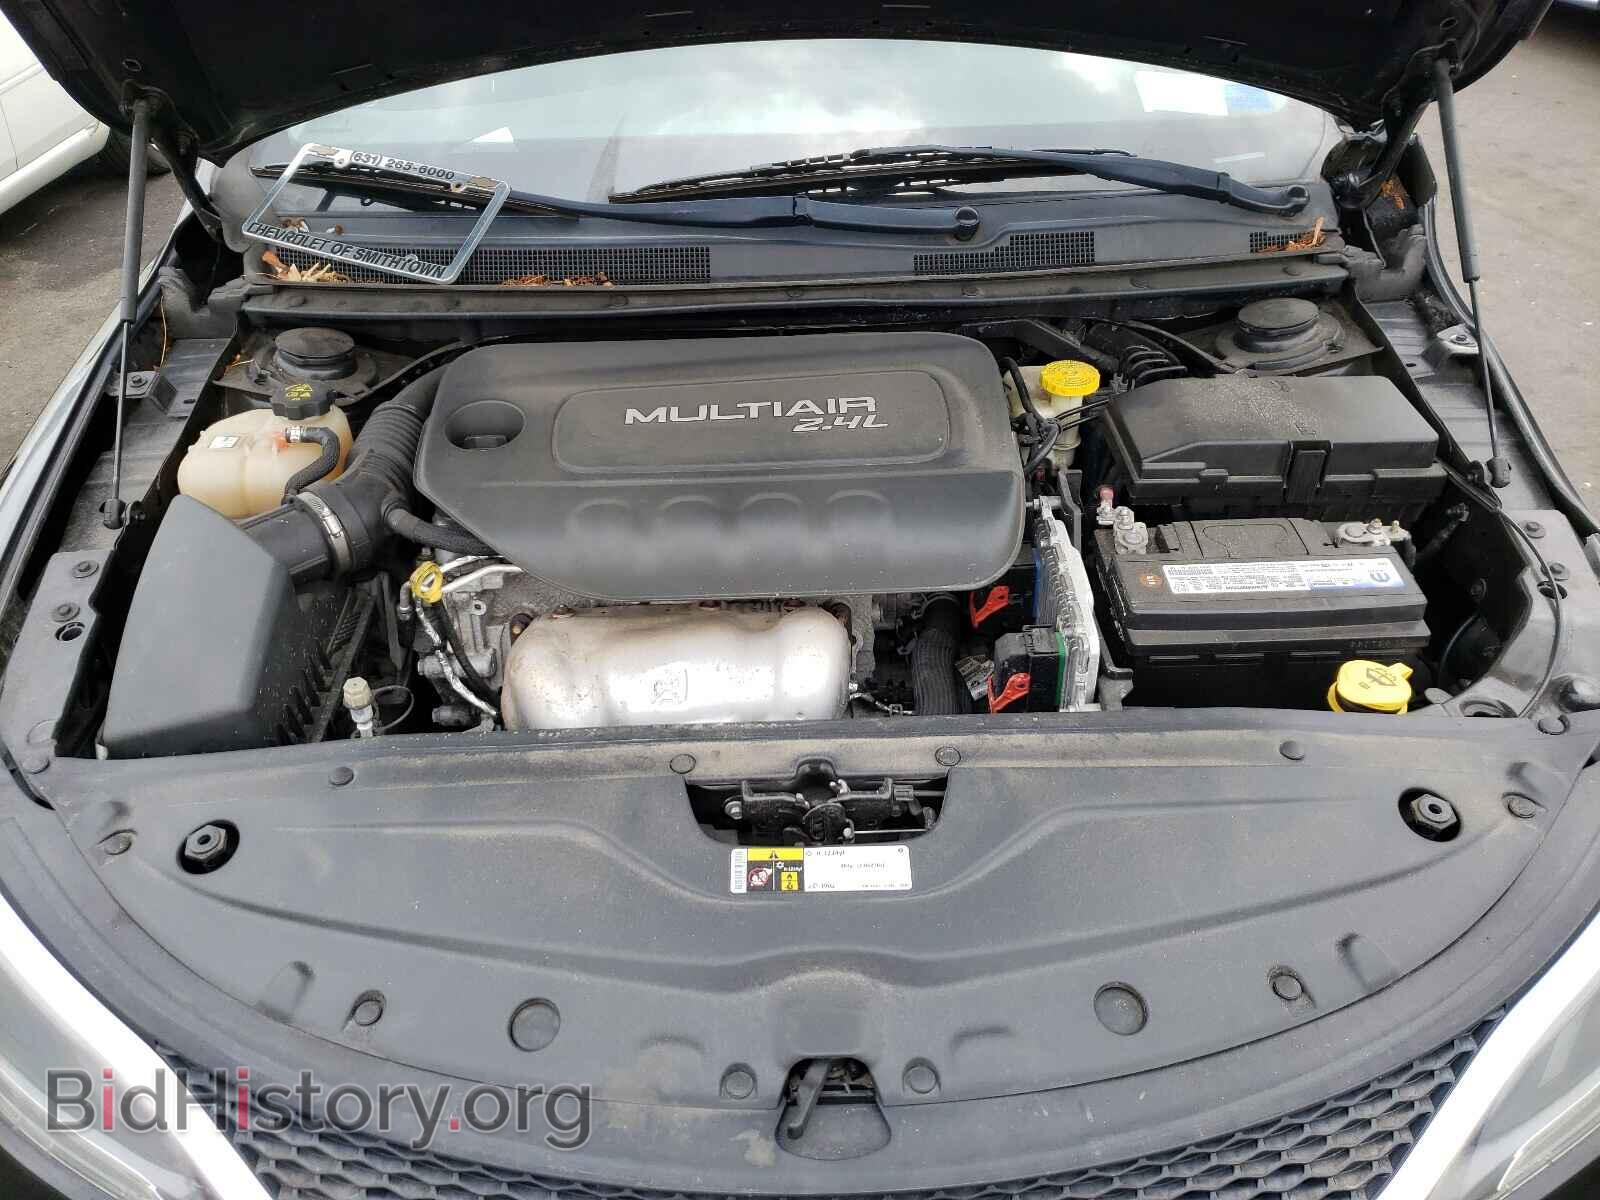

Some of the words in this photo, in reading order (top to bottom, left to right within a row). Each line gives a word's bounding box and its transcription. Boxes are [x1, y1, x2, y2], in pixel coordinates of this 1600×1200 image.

[350, 151, 383, 167] (631)
[385, 158, 455, 180] 265-6000
[248, 222, 331, 251] CHEVROLET
[331, 240, 355, 256] OF
[353, 248, 447, 277] SMITHTOWN
[624, 396, 878, 425] MULTIAIR
[792, 413, 888, 432] 2.4L
